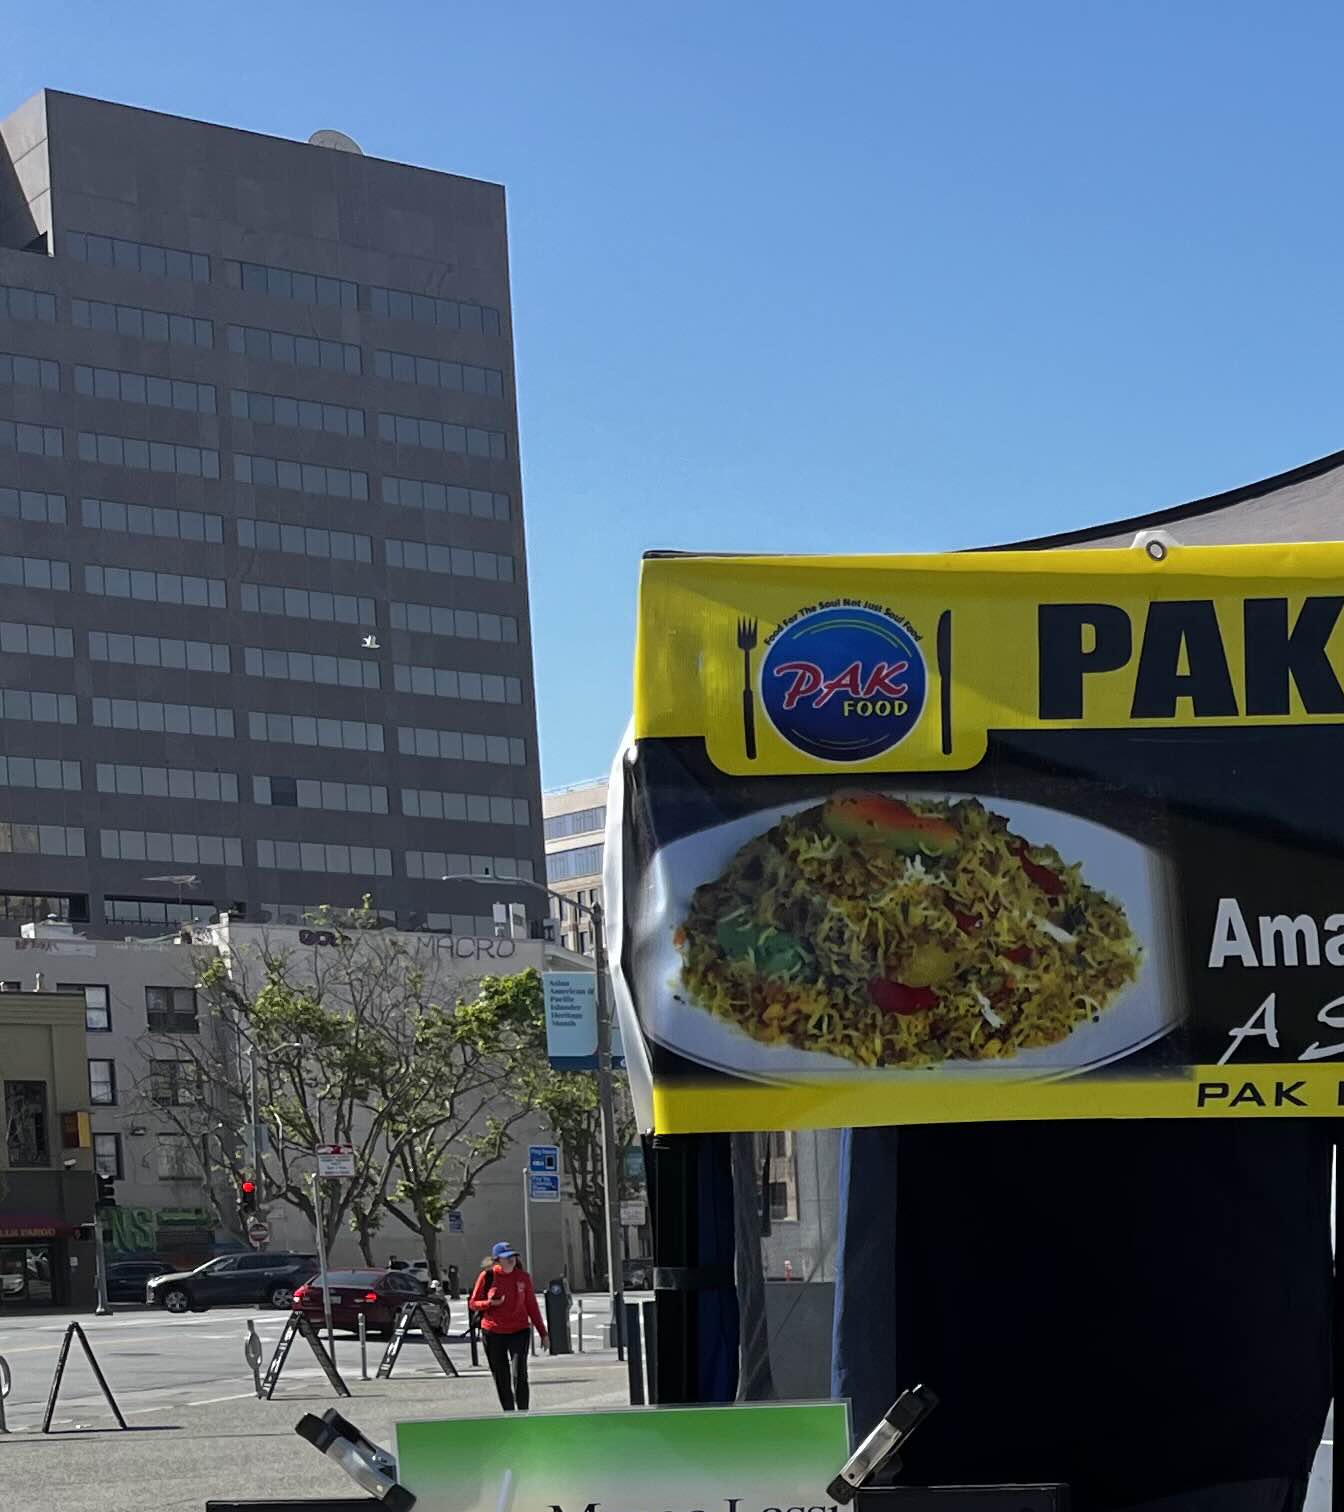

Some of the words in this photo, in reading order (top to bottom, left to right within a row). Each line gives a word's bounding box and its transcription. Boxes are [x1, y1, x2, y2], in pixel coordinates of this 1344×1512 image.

[764, 624, 782, 645] Food
[799, 605, 816, 617] The
[819, 599, 840, 608] Soul
[863, 601, 882, 612] Just
[774, 661, 908, 709] PAK
[844, 700, 908, 716] FOOD
[416, 936, 516, 960] MACRO
[1217, 992, 1280, 1066] A
[1196, 1081, 1307, 1108] PAK
